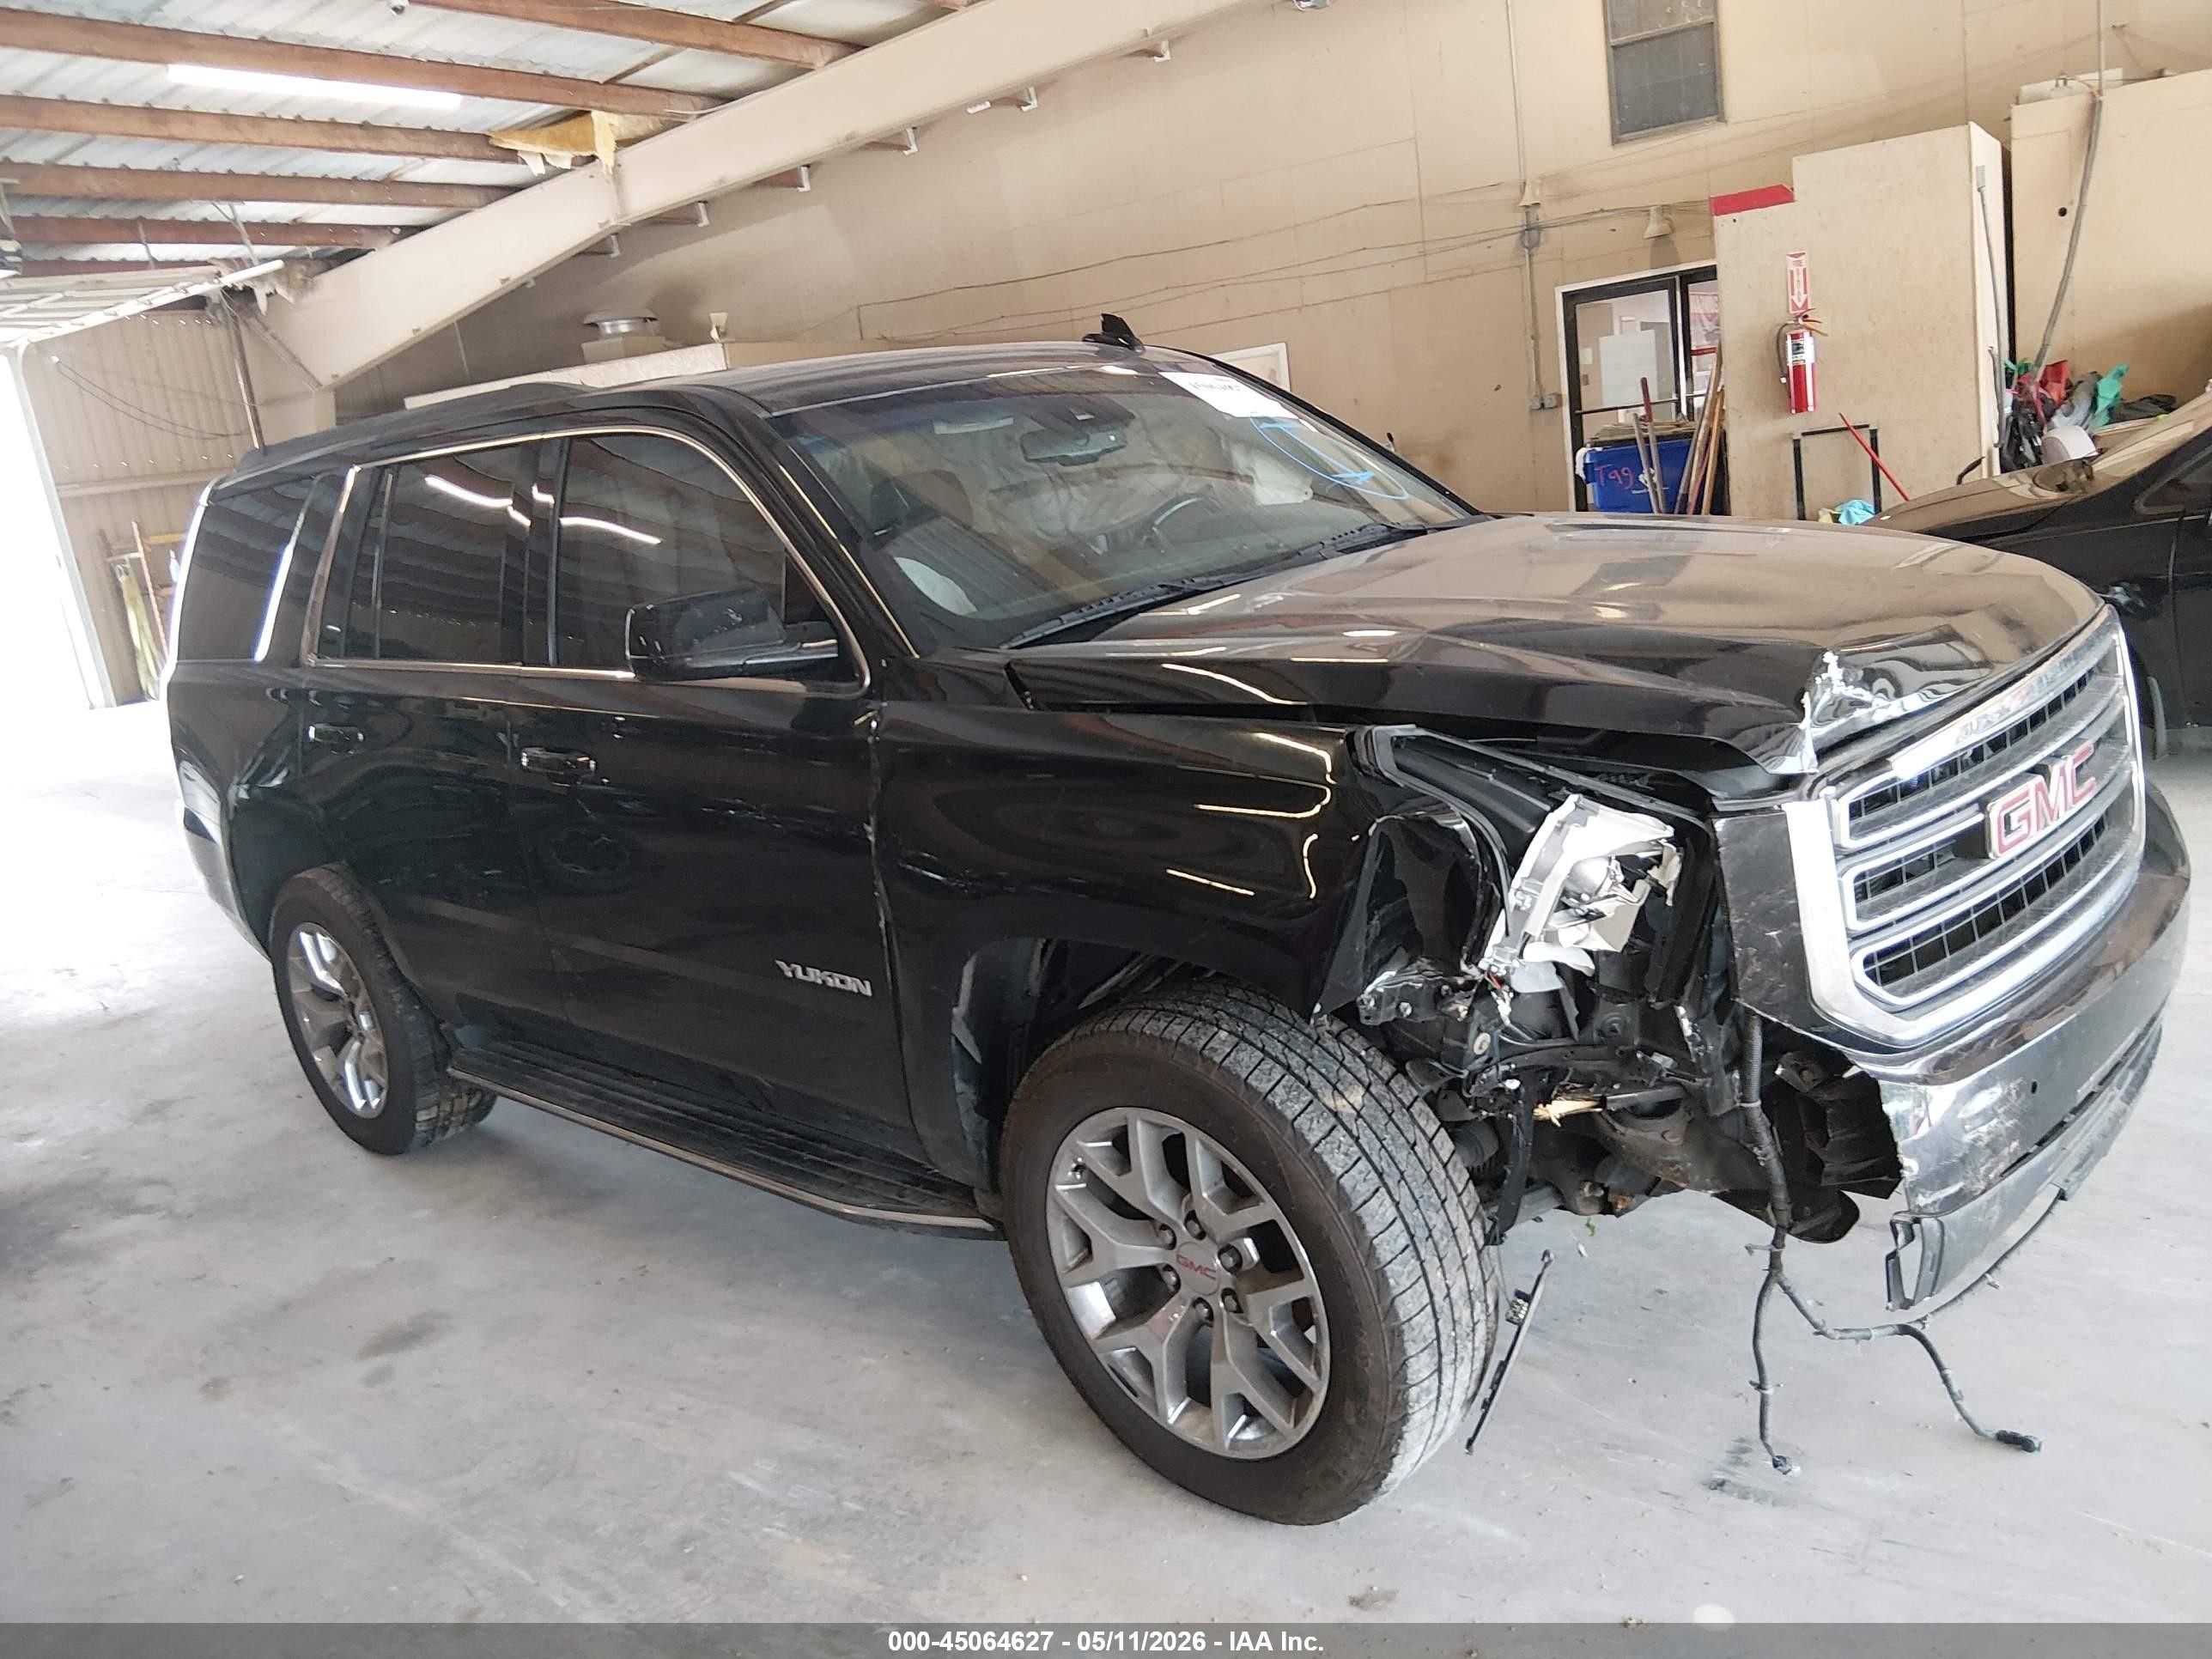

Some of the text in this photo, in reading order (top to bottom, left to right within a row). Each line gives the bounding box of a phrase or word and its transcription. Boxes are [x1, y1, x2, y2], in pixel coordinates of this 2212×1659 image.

[1989, 740, 2096, 858] GMC
[775, 959, 872, 997] YUKON
[1176, 1253, 1217, 1280] GMC
